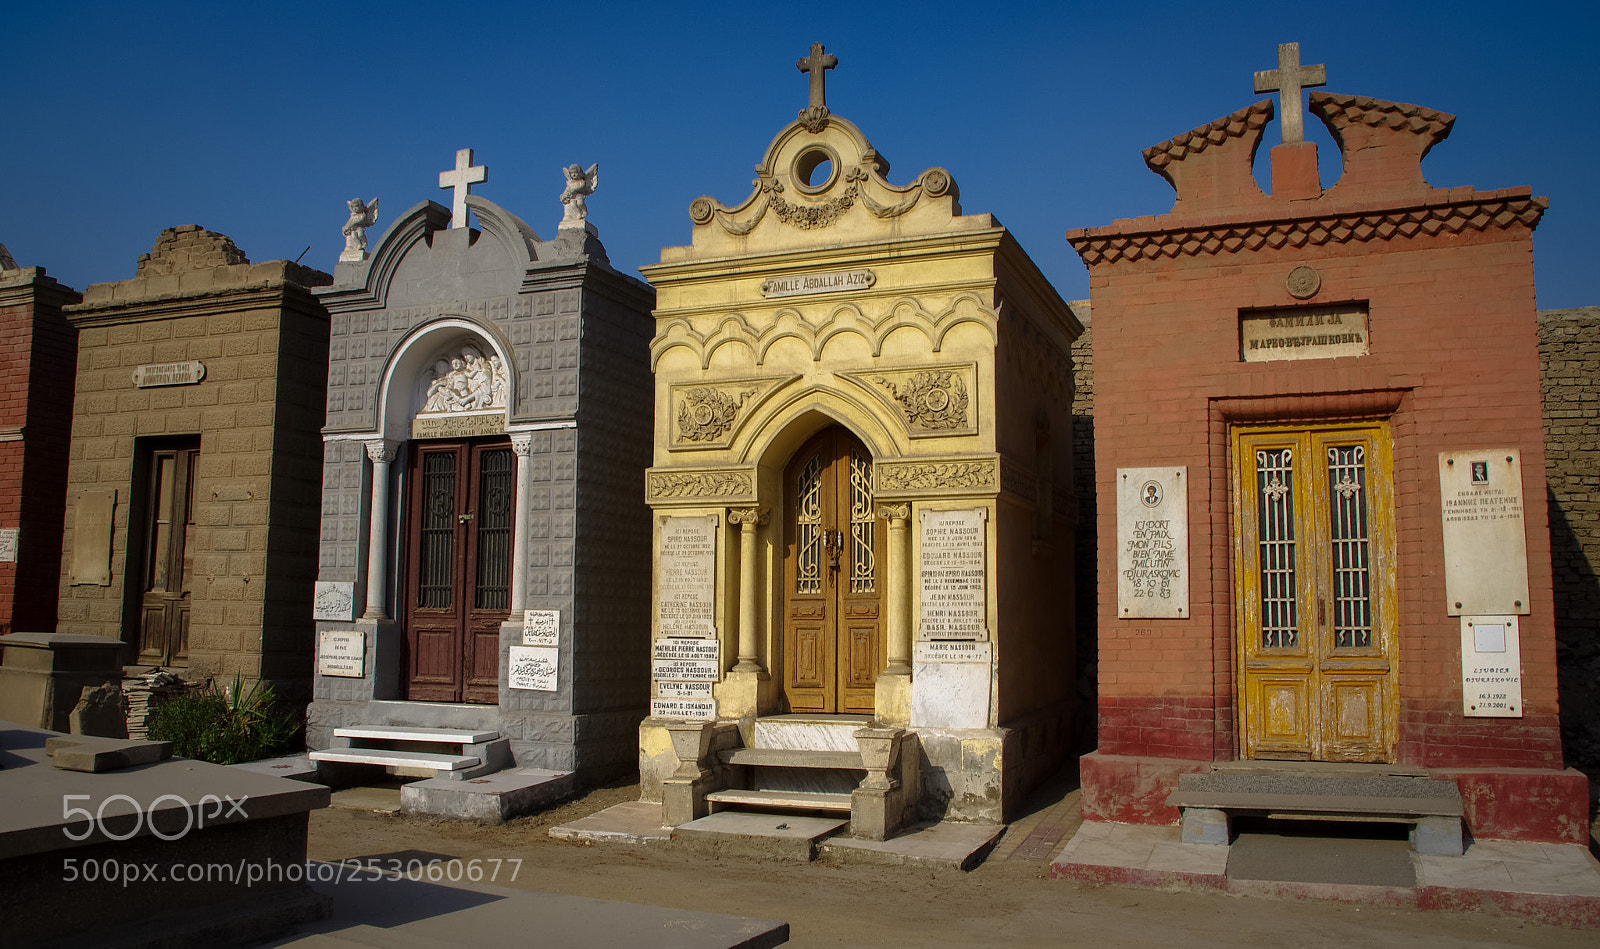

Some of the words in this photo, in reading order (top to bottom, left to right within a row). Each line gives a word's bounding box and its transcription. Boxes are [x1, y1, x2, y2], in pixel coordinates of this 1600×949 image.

[768, 280, 800, 292] FAMILLE
[803, 276, 844, 289] ABDALLAH
[846, 273, 866, 284] AZIZ
[1146, 520, 1170, 529] DORT
[1133, 528, 1150, 538] EN
[1146, 530, 1175, 540] PAIX
[1127, 540, 1149, 551] MON
[1153, 540, 1173, 549] FILS
[1133, 548, 1154, 558] BIEN
[1131, 558, 1174, 570] MILUTIN
